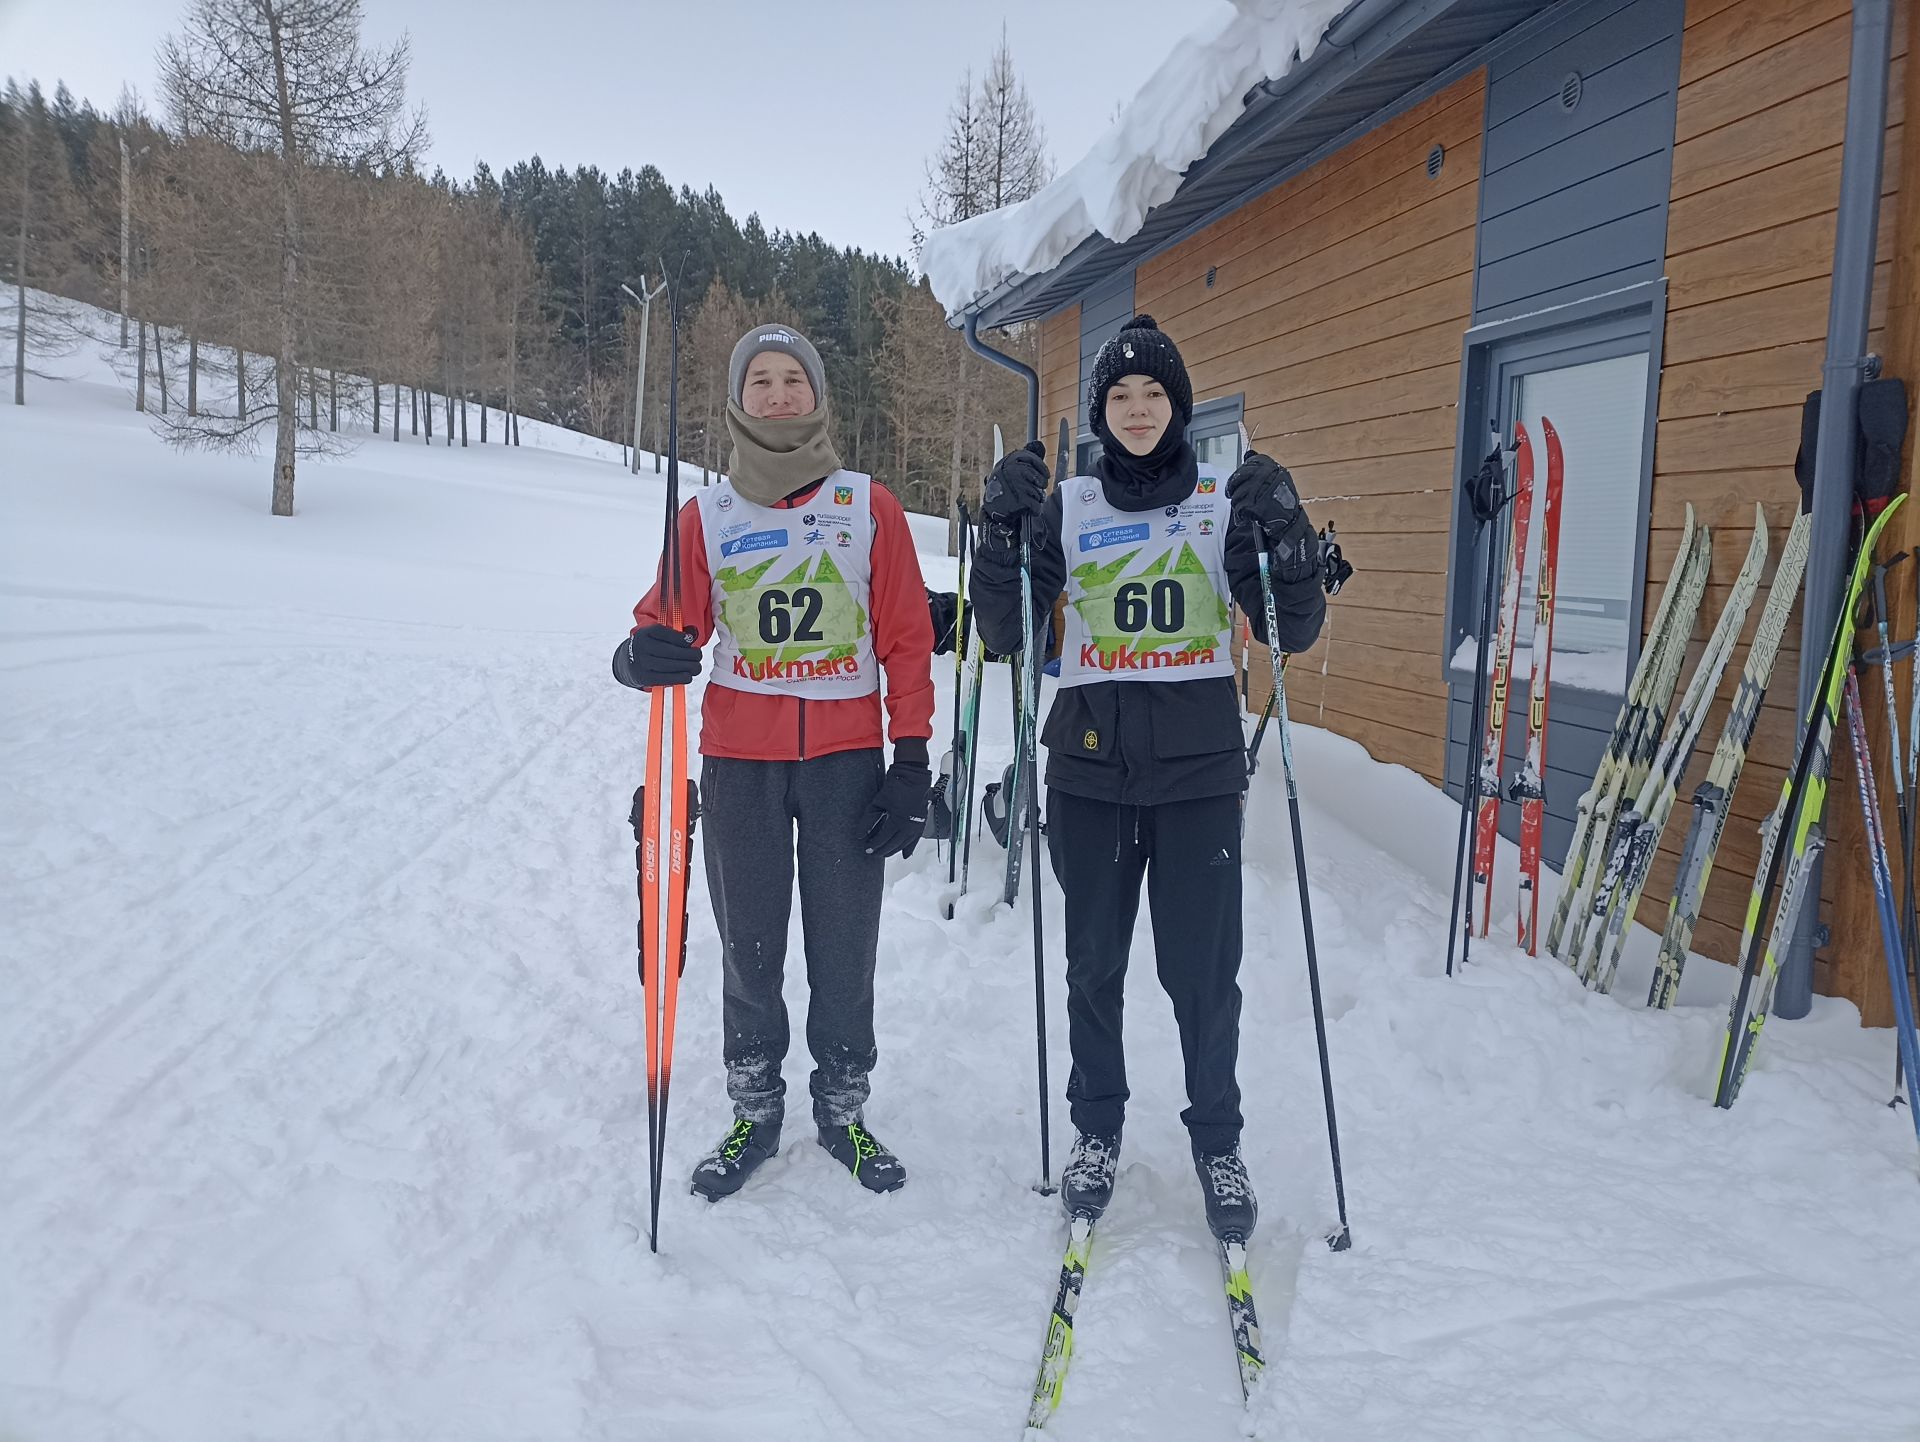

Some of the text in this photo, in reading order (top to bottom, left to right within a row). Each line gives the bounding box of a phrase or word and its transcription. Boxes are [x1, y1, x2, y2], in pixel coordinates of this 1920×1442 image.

[759, 333, 789, 344] PUMA
[741, 534, 771, 544] Сетевая
[742, 540, 778, 549] Компания
[1102, 528, 1133, 538] Сетевая
[1103, 533, 1140, 544] Компания
[758, 587, 823, 644] 62
[1114, 579, 1185, 633] 60
[732, 654, 858, 682] Kukmara
[1080, 643, 1215, 671] Kukmara
[1711, 770, 1739, 852] JARVINEN
[1756, 804, 1785, 889] SABLE
[1772, 855, 1801, 943] SABLE
